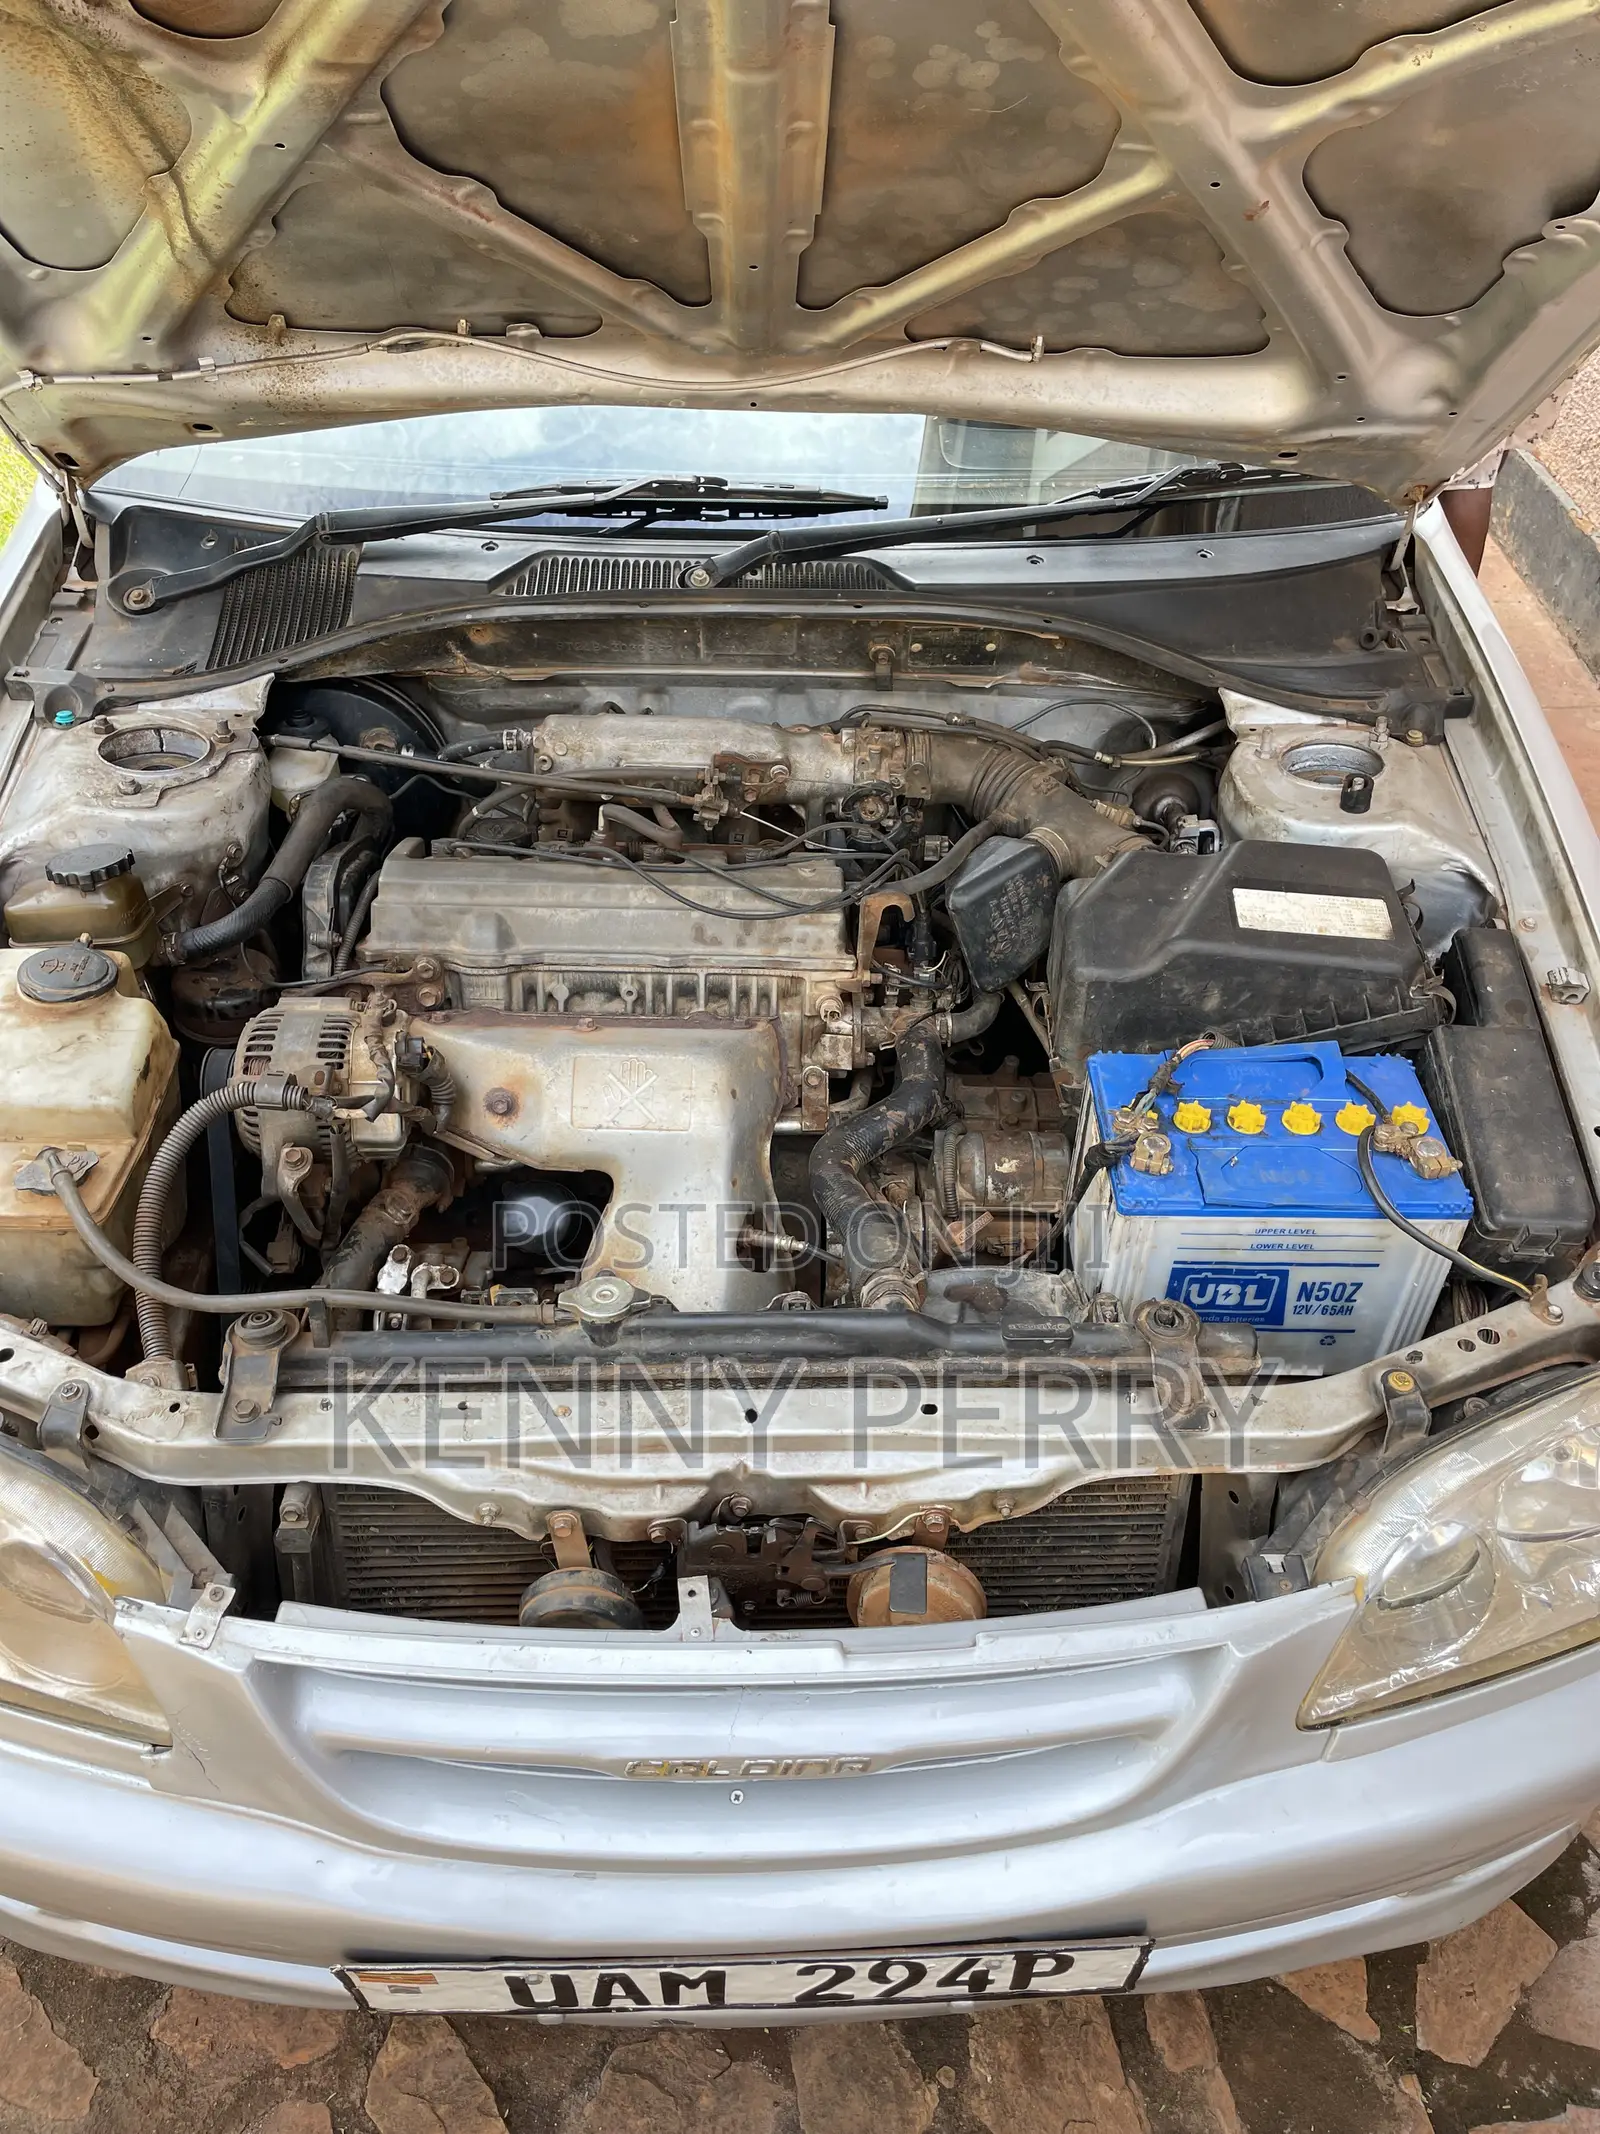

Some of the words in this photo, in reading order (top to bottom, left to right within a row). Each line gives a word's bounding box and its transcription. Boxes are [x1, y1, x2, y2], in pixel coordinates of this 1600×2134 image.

[1187, 1283, 1269, 1306] UBL
[1296, 1281, 1363, 1303] N50Z
[1222, 1315, 1265, 1323] Batteries
[1292, 1304, 1355, 1316] 12V/65AH
[624, 1756, 872, 1778] CALDINA
[503, 1968, 727, 2008] UAM
[795, 1951, 1076, 2001] 294P
